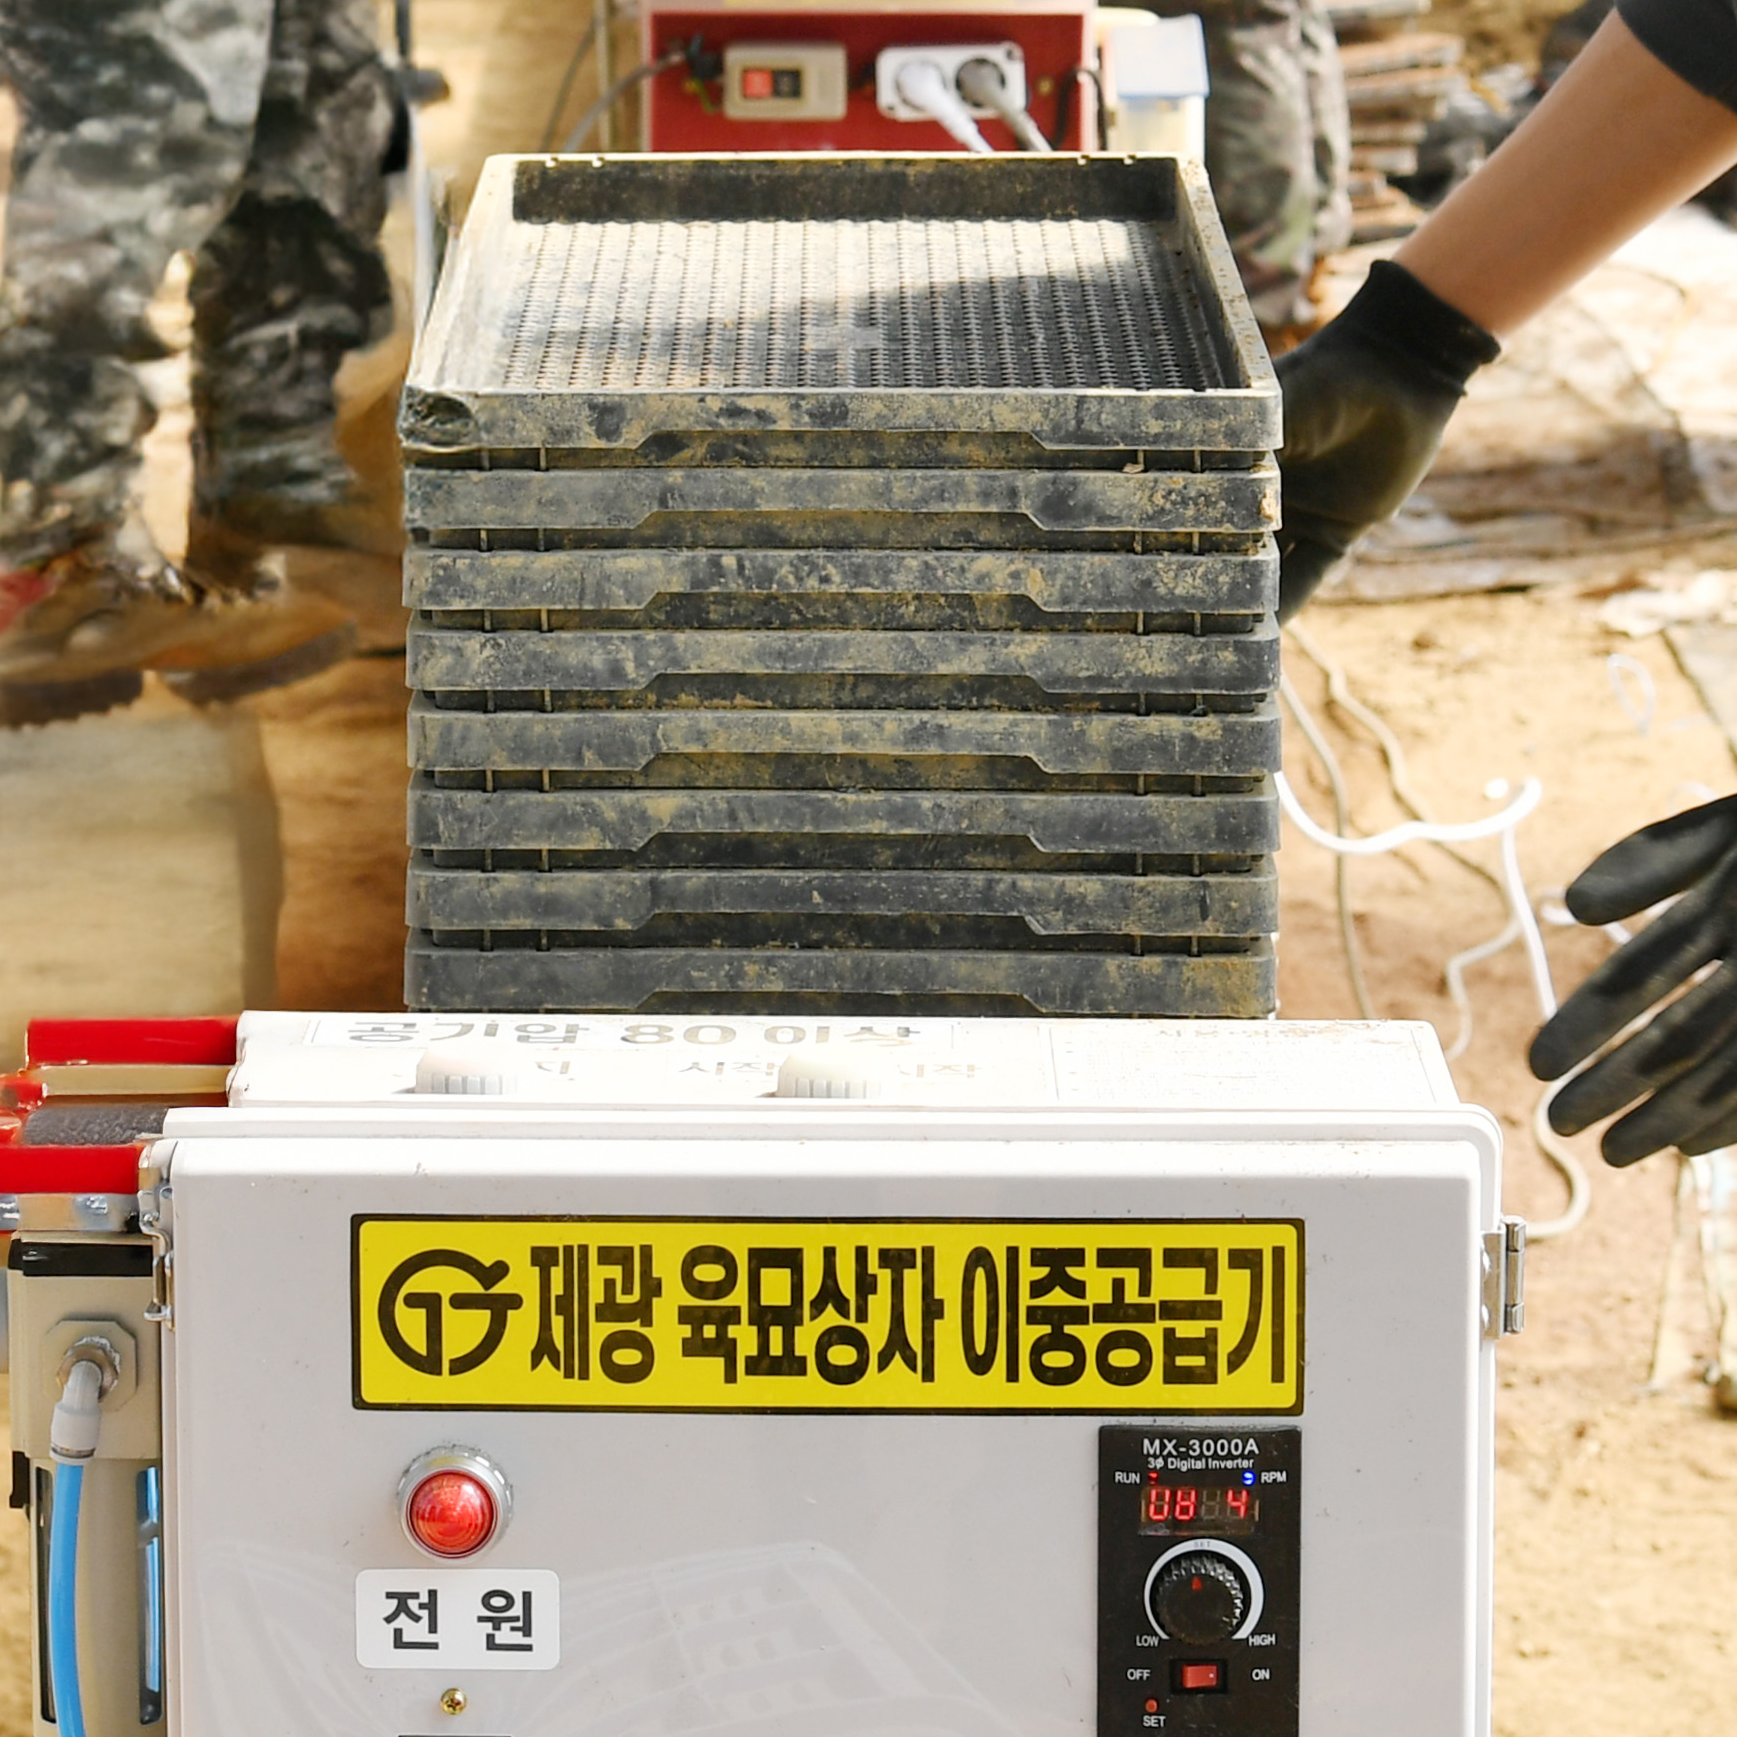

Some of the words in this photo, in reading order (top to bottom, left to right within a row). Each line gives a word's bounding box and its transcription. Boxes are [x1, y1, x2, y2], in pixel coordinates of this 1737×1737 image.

[348, 1019, 591, 1046] 공기압
[619, 1023, 738, 1046] 80
[763, 1024, 922, 1048] 이상
[530, 1244, 662, 1384] 제광
[677, 1245, 944, 1385] 육묘상자
[960, 1244, 1287, 1385] 이중공급기
[1143, 1438, 1260, 1456] MX-3000A
[1168, 1457, 1206, 1472] Digital
[1208, 1457, 1254, 1470] Inverter
[1115, 1471, 1141, 1485] RUN
[1261, 1470, 1287, 1484] RPM
[1193, 1540, 1212, 1549] SET
[1136, 1635, 1160, 1647] LOW
[1248, 1634, 1276, 1647] HIGH
[1127, 1668, 1151, 1681] OFF
[1251, 1668, 1270, 1681] ON
[1143, 1715, 1166, 1728] SET
